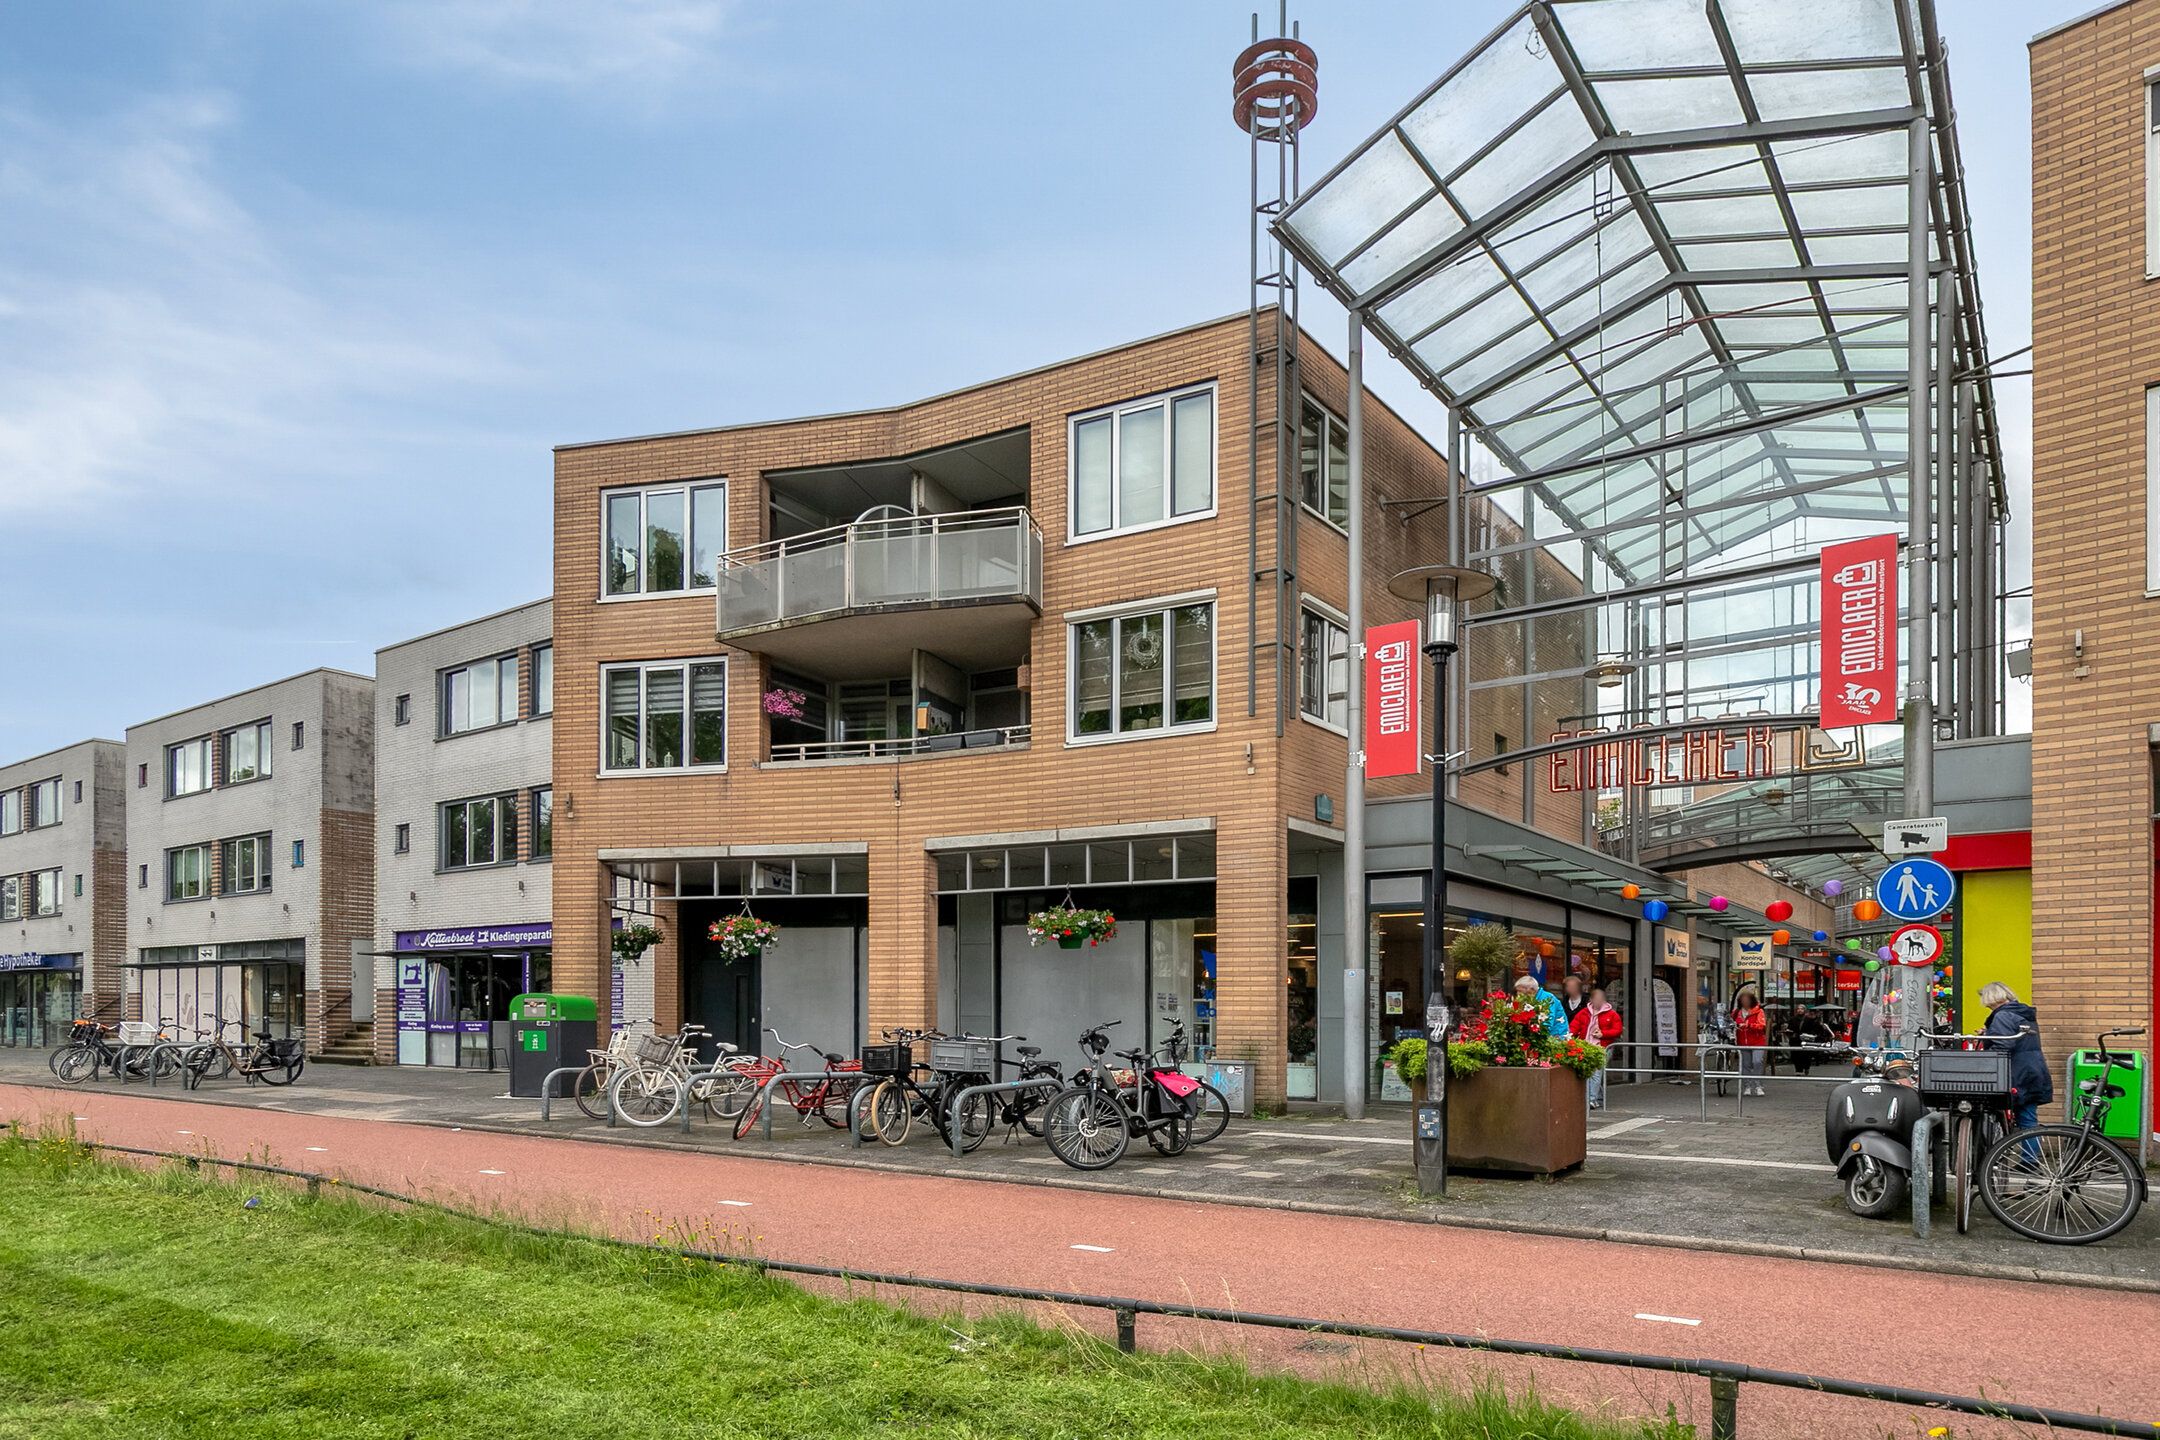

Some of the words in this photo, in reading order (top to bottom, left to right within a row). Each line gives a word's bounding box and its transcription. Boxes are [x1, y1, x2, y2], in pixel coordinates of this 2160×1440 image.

[1841, 586, 1876, 675] EMICLAER
[1380, 662, 1405, 735] EMICLAER
[1888, 822, 1943, 830] Cameratoezicht
[421, 931, 475, 947] Kattenbroek
[490, 930, 552, 943] Kledingreparati
